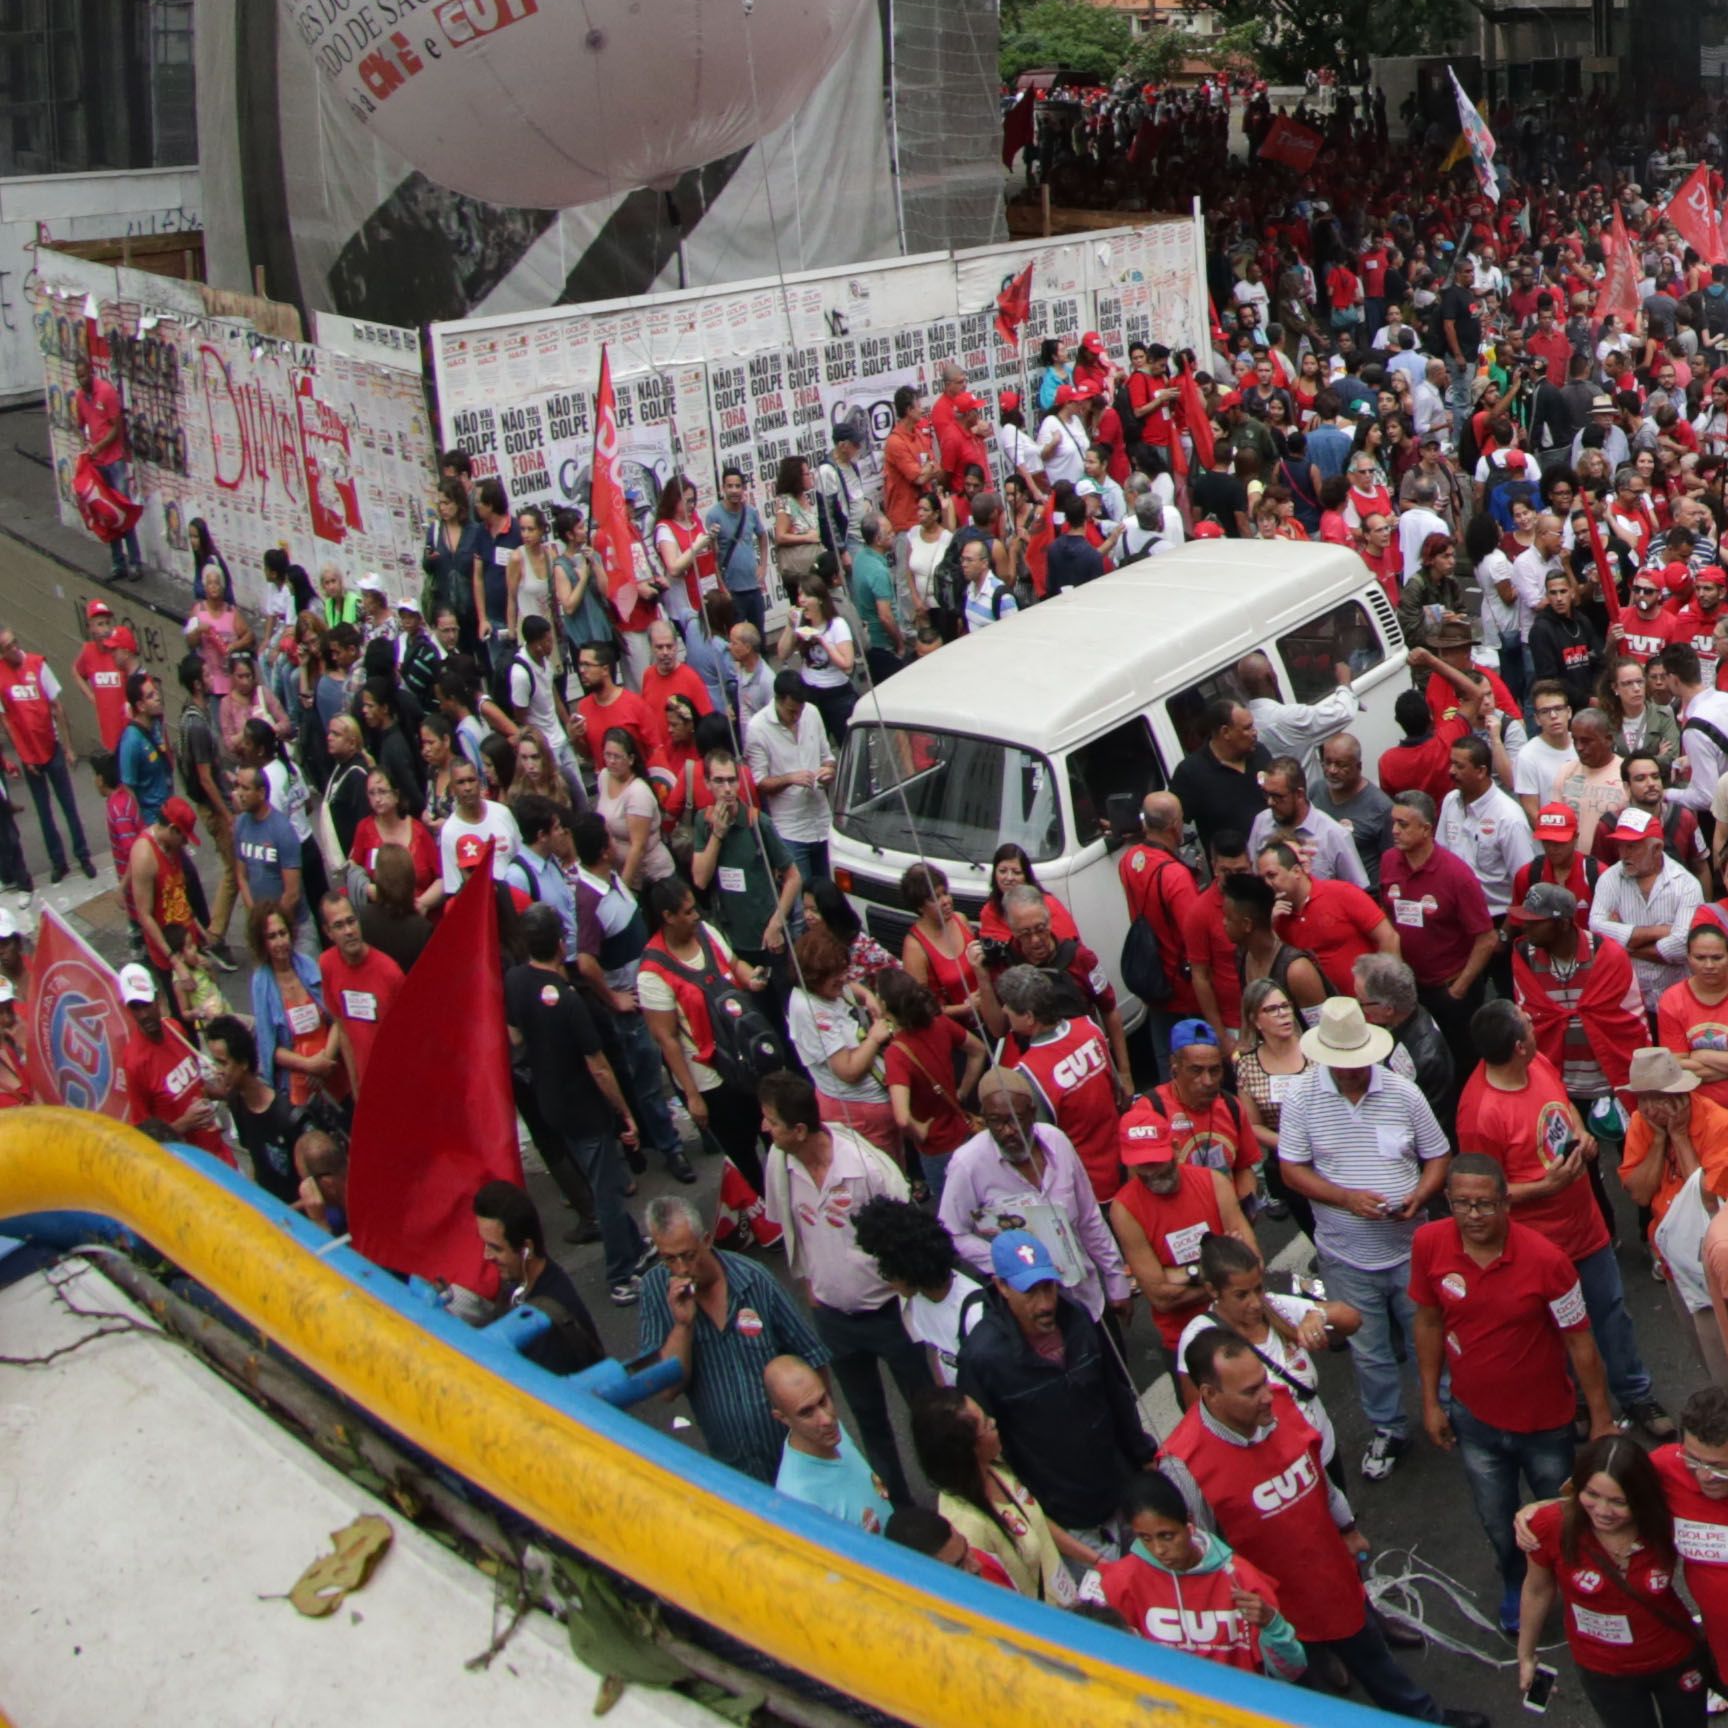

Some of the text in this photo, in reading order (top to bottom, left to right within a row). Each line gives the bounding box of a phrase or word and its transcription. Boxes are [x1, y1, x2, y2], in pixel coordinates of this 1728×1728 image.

[352, 11, 382, 52] DE
[424, 38, 442, 60] e
[749, 354, 769, 377] NÃO
[712, 366, 733, 392] NÃO
[751, 373, 784, 397] GOLPE
[715, 387, 746, 411] GOLPE
[755, 393, 784, 415] FORA
[501, 407, 525, 434] NÃO
[719, 406, 747, 430] FORA
[755, 409, 788, 433] CUNHA
[505, 428, 544, 455] GOLPE
[719, 425, 751, 450] CUNHA
[512, 449, 545, 476] FORA
[511, 471, 551, 497] CUNHA
[11, 683, 38, 699] CUT
[95, 672, 119, 686] CUT
[1539, 814, 1565, 826] CUT
[165, 1056, 199, 1094] CUT
[1053, 1037, 1105, 1090] CUT
[1127, 1126, 1157, 1139] CUT
[1252, 1453, 1317, 1513] CUT
[1677, 1530, 1726, 1545] GOLPE
[1683, 1546, 1722, 1562] NÃO!
[1144, 1606, 1243, 1641] CUT
